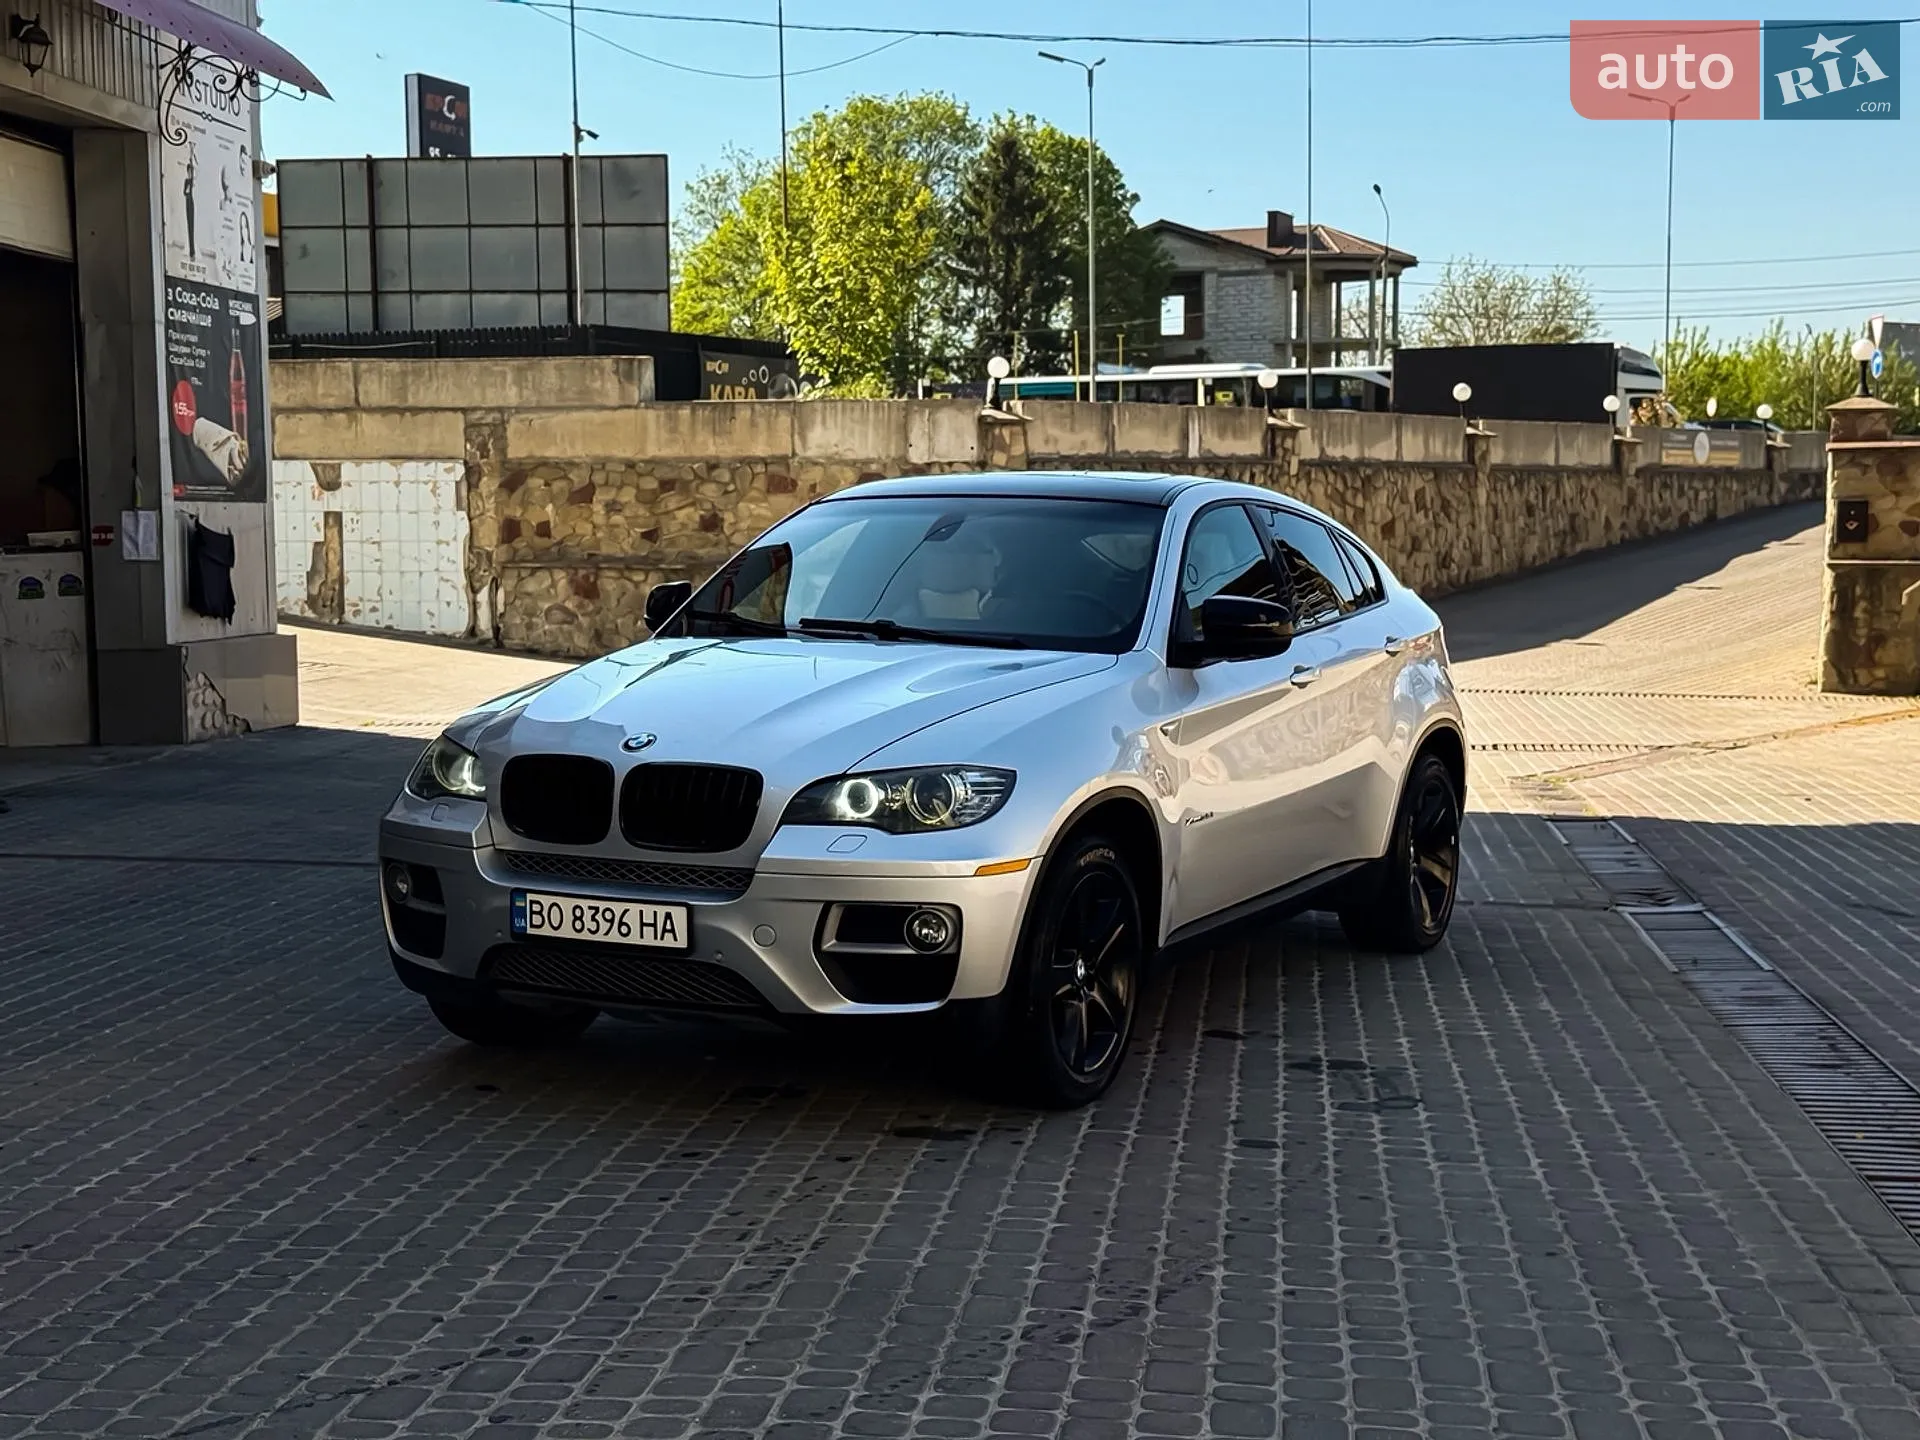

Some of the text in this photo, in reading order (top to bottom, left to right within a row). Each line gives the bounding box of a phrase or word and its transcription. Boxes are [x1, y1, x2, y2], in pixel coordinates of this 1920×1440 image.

[514, 917, 526, 928] UA
[529, 899, 679, 942] BO 8396 HA
